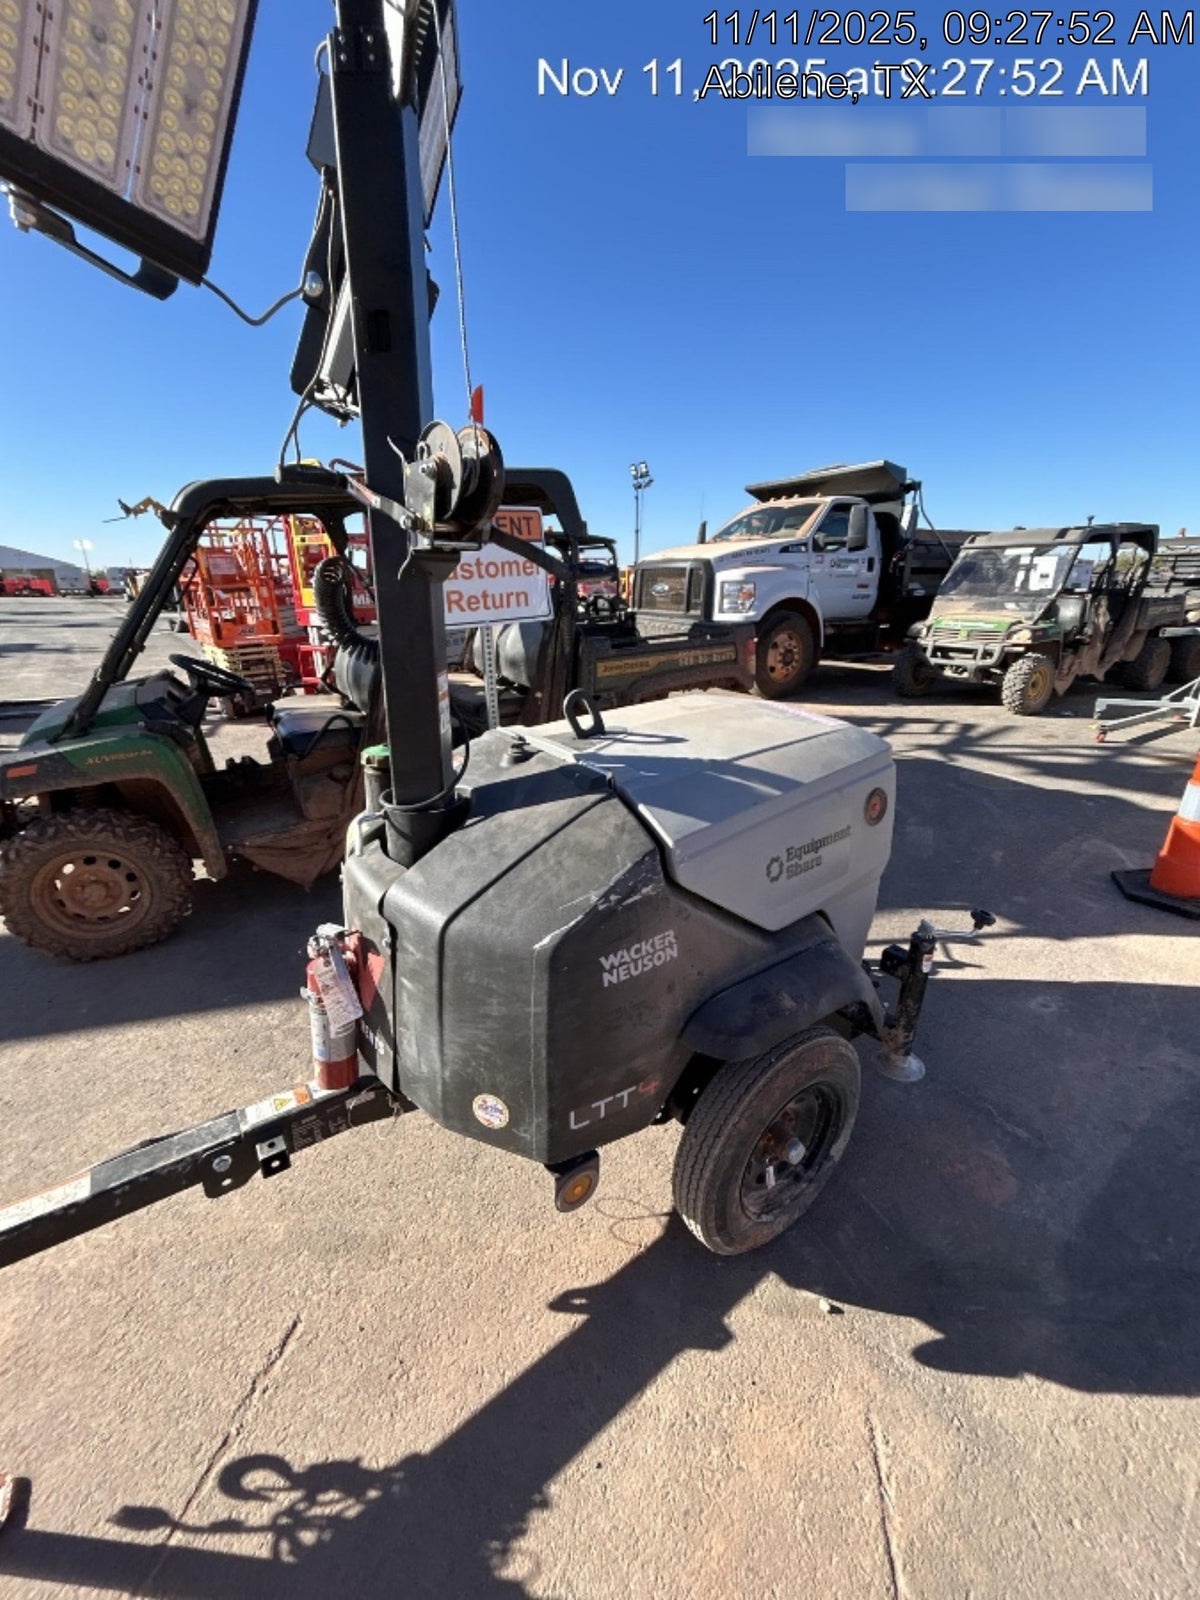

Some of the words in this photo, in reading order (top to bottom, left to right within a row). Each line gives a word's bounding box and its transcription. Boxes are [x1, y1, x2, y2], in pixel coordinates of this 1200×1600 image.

[445, 589, 530, 614] Return
[785, 825, 852, 862] Equipment
[786, 854, 823, 880] Share
[599, 929, 678, 970] WACKER
[602, 944, 679, 987] NEUSON
